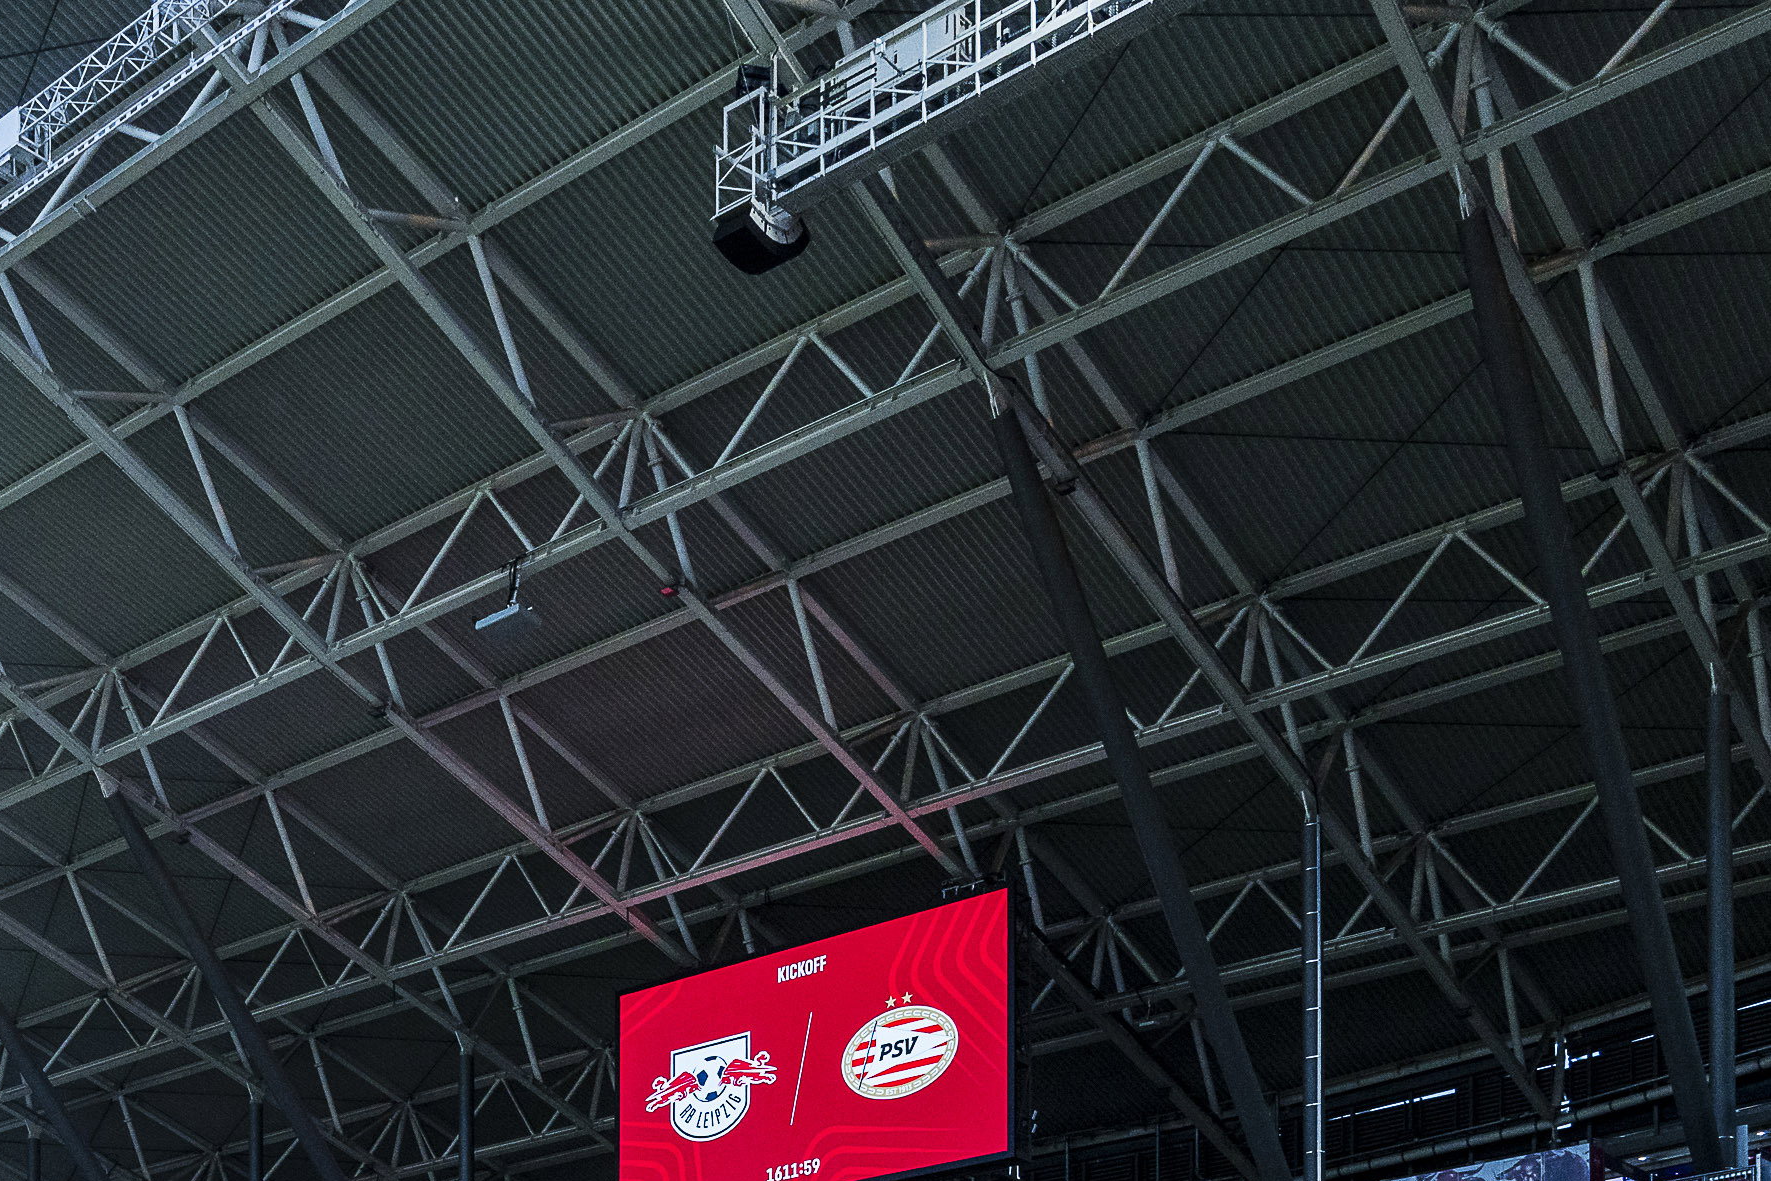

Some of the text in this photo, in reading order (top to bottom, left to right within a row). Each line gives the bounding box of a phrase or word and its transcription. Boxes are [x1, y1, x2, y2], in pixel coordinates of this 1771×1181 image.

[777, 954, 827, 983] KICKOFF
[878, 1035, 919, 1062] PSV
[679, 1093, 742, 1129] RB LEIPZIG
